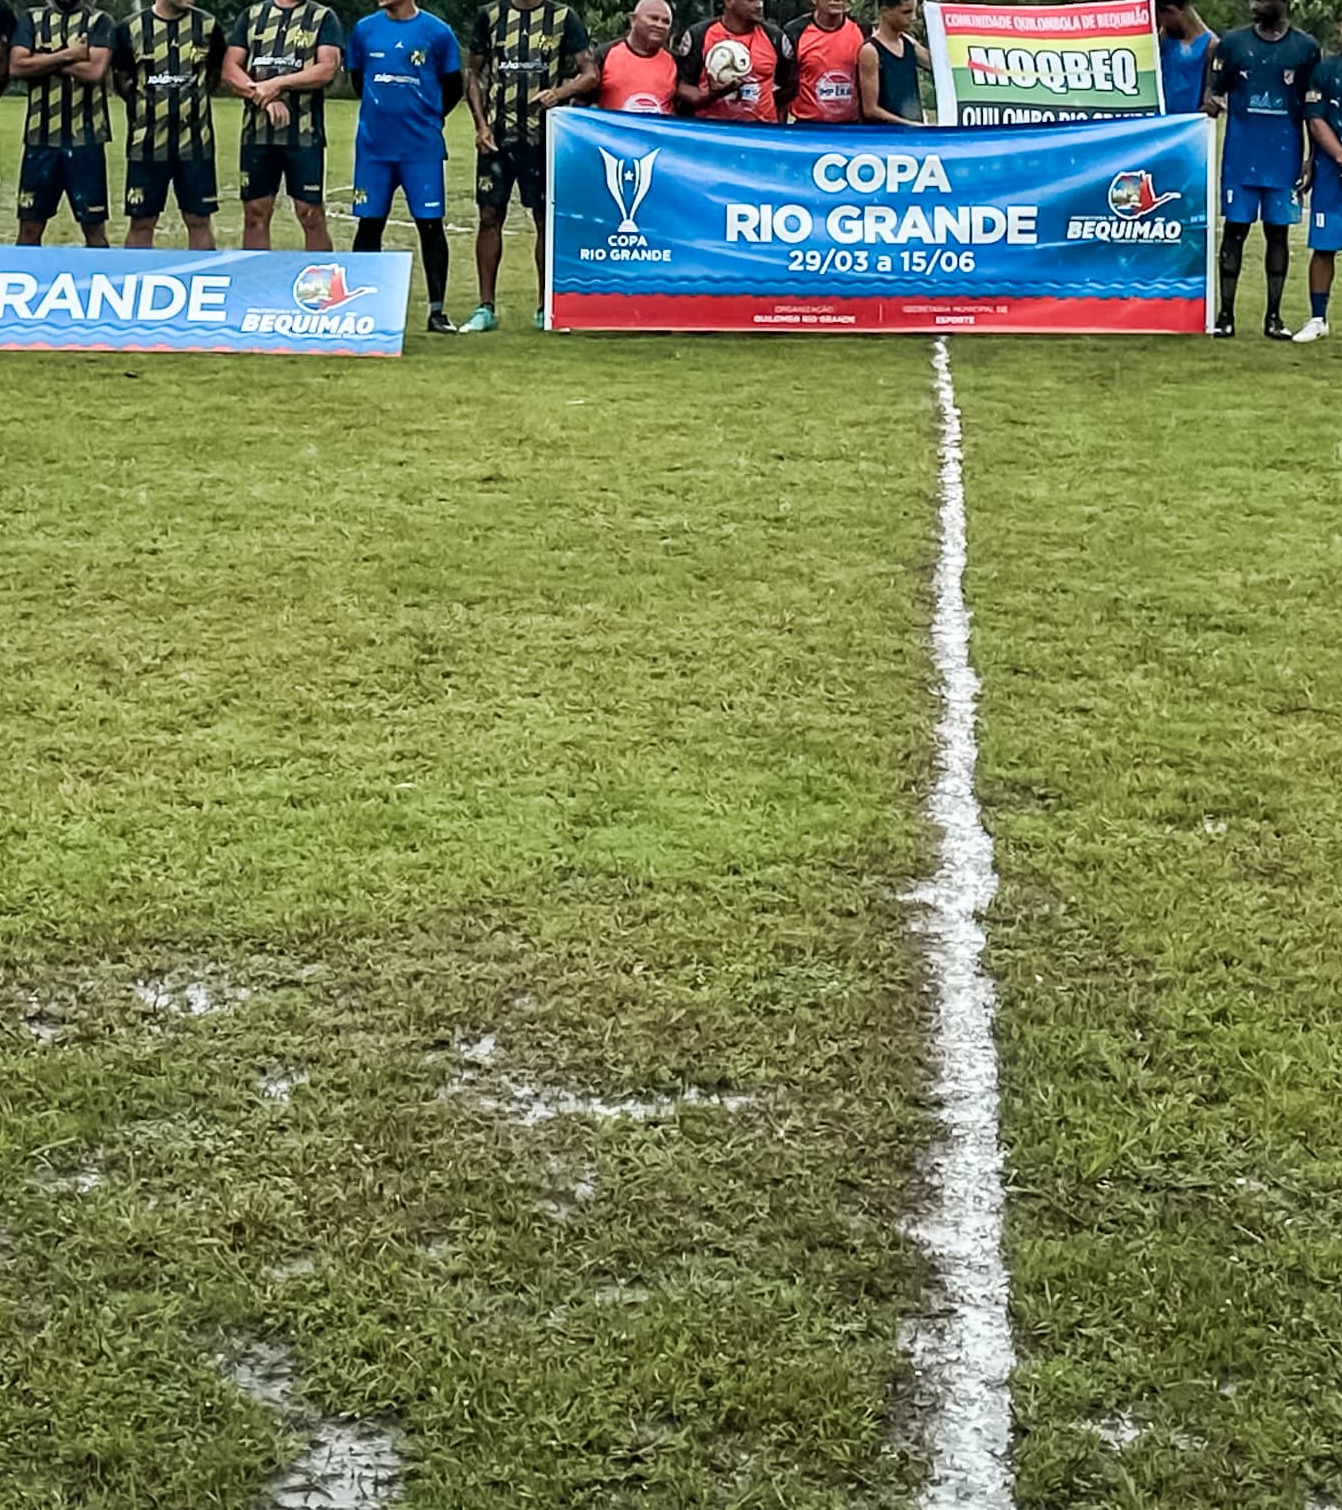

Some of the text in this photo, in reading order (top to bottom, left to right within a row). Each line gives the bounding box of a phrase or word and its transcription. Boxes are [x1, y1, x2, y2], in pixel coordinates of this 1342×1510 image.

[945, 8, 1149, 32] COMUNIDADE QUILOMBOLA DE BEQUIMÃO
[969, 46, 1138, 96] MOQBEQ
[812, 153, 952, 194] COPA
[726, 203, 1038, 245] RIO GRANDE
[1067, 217, 1182, 243] BEQUIMÃO
[607, 235, 648, 247] COPA
[580, 248, 672, 262] RIO GRANDE
[788, 249, 975, 275] 29/03 a 15/06
[240, 311, 375, 337] BEQUIMÃO
